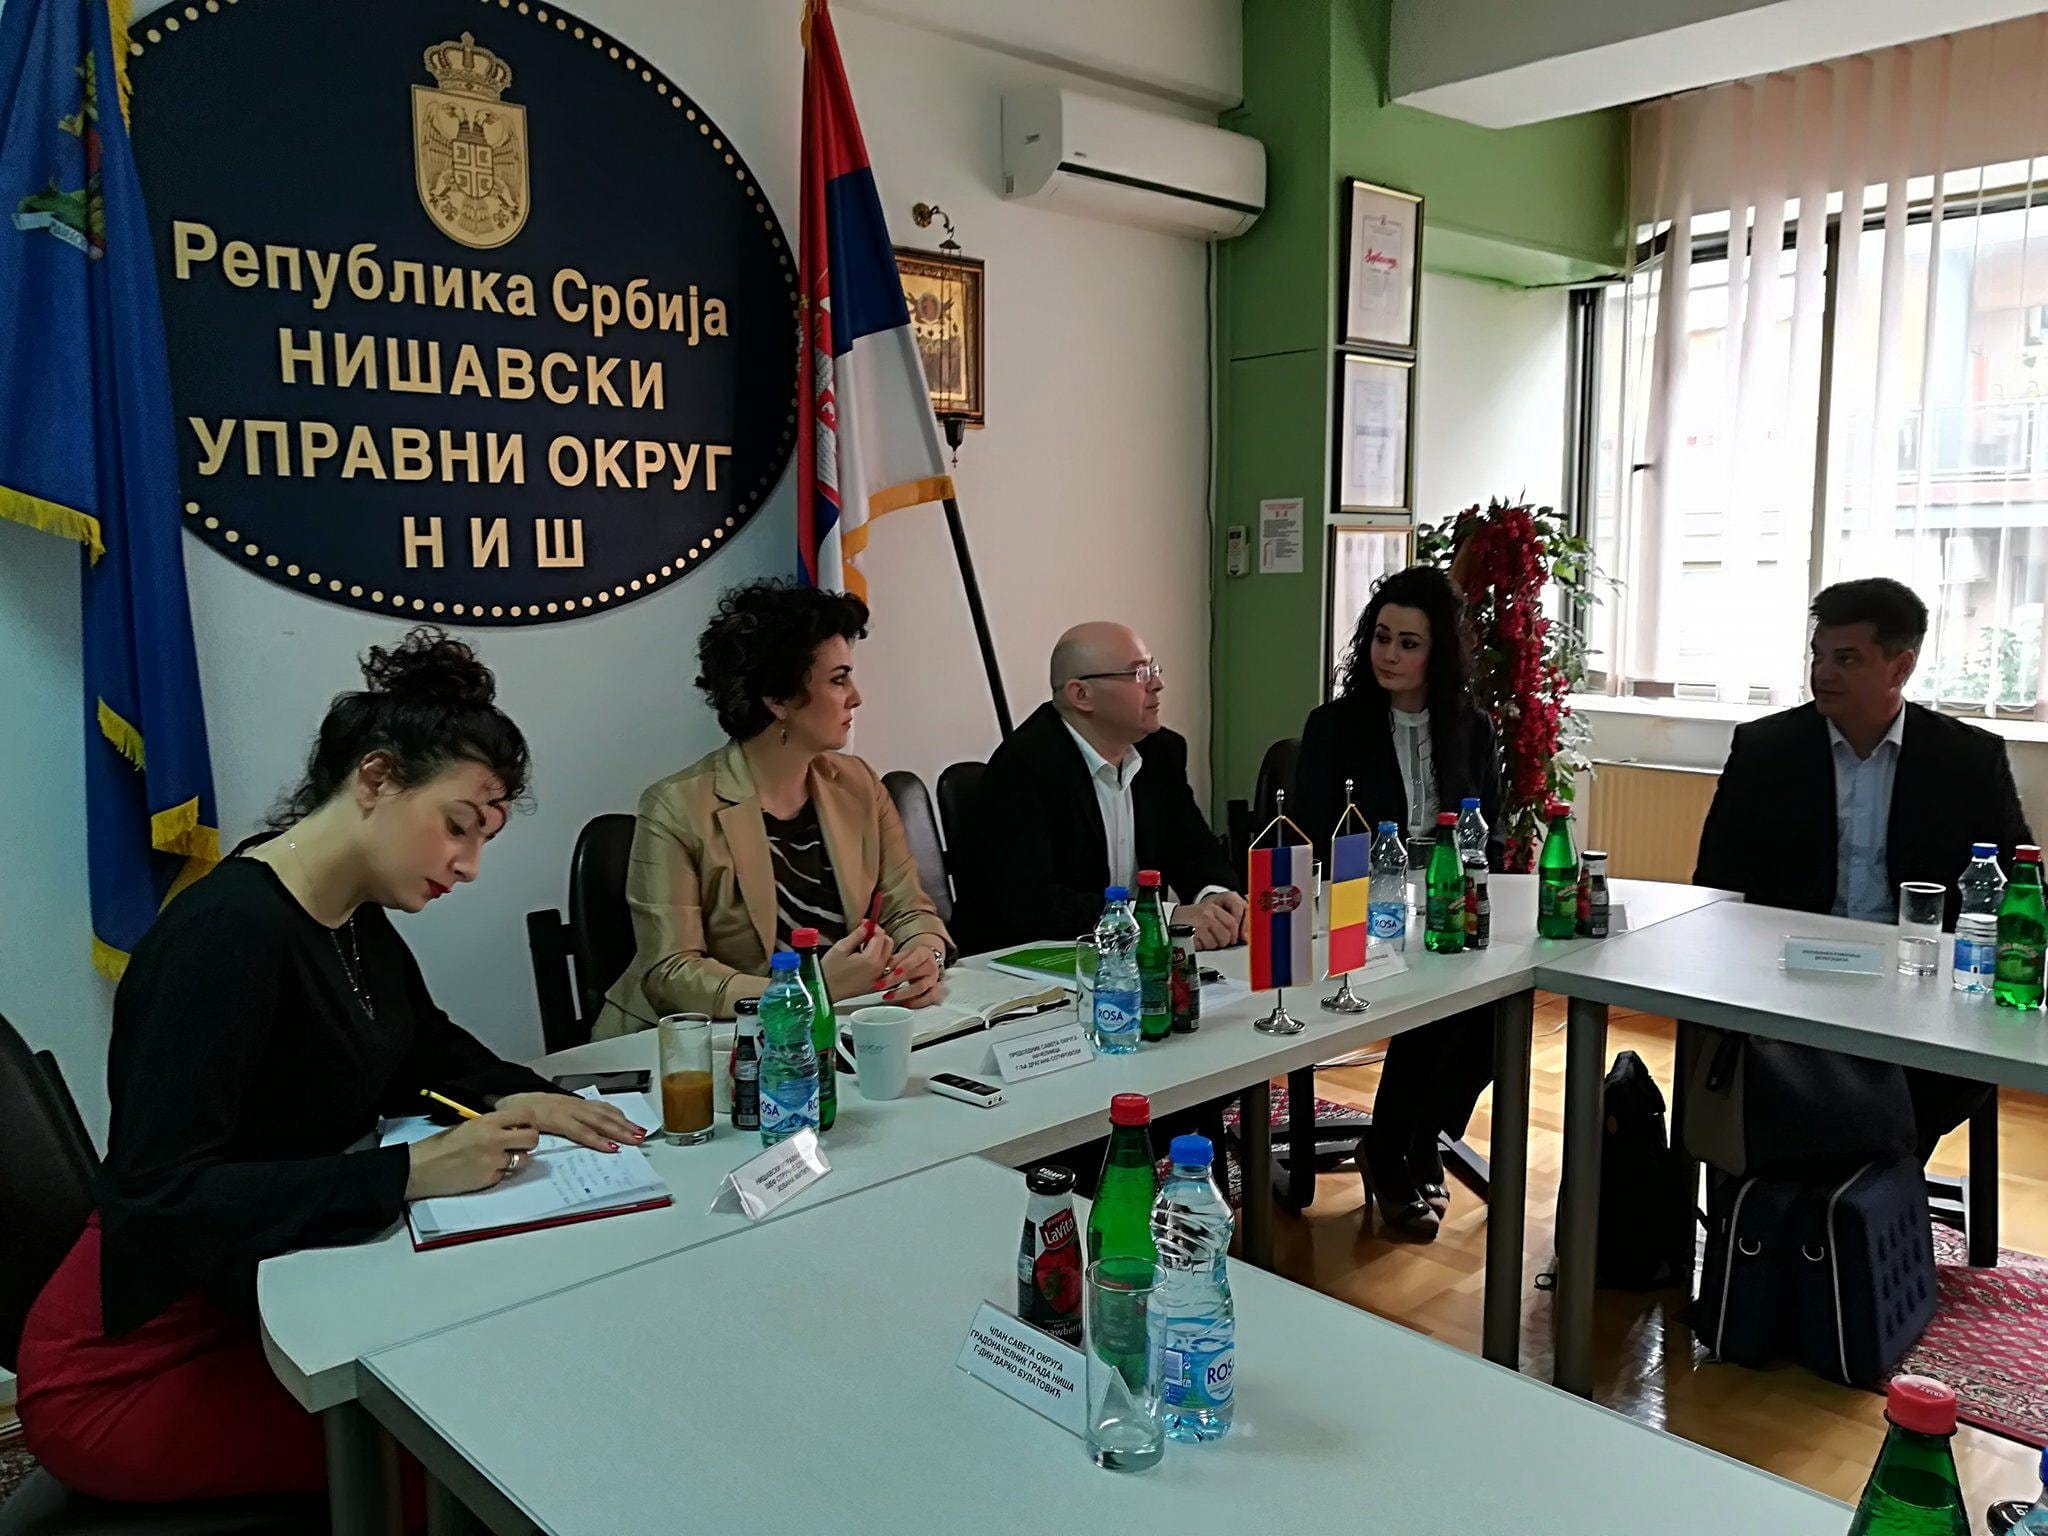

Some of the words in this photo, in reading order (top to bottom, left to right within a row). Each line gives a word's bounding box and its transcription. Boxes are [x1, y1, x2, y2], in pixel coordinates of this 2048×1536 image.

[173, 220, 537, 318] Република
[552, 267, 729, 346] Србија
[278, 327, 665, 411] НИШАВСКИ
[188, 416, 526, 485] УПРАВНИ
[547, 435, 734, 492] ОКРУГ
[761, 1100, 780, 1116] OSA
[1044, 1218, 1074, 1245] LaVita
[970, 1330, 1029, 1366] ГРАДОНАЧЕЛНИК
[1028, 1361, 1051, 1380] ГРАДА
[1051, 1374, 1074, 1392] НИША
[990, 1326, 1008, 1342] ЧЛАН
[1007, 1337, 1035, 1356] САВЕТА
[1036, 1352, 1063, 1372] ОКРУГА
[1207, 1358, 1233, 1385] ROS
[993, 1355, 1018, 1374] ДАРКО
[1017, 1368, 1061, 1399] БУЛАТОВИЋ
